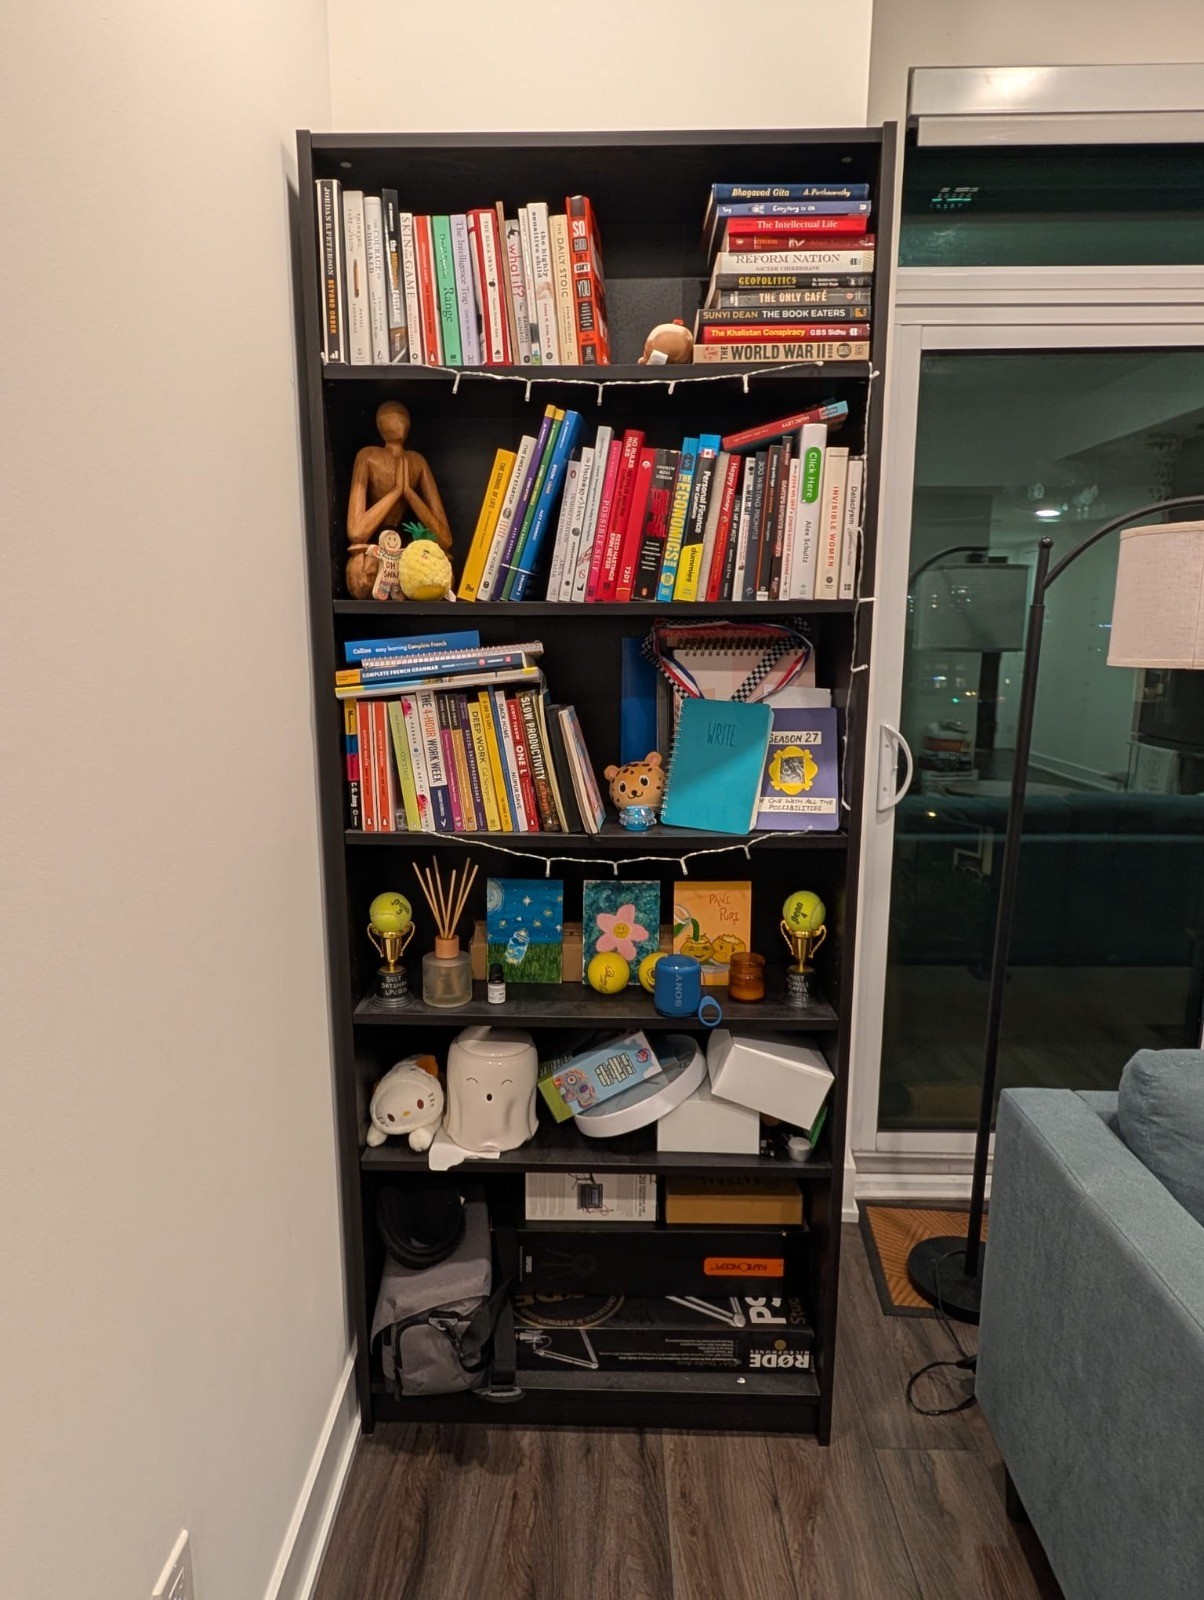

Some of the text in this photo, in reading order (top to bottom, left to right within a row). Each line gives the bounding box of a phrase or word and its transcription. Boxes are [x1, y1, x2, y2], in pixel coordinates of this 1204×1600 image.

[324, 187, 335, 221] JORDAN
[732, 188, 790, 201] Bhagavad Gita
[402, 217, 410, 248] SKIN
[572, 221, 586, 237] SO
[757, 220, 838, 229] The Intellectual Life
[326, 230, 335, 276] PETERSON
[374, 230, 382, 271] COURAGE
[532, 212, 544, 279] sensitive child
[456, 222, 472, 306] The Intelligence Trap
[508, 244, 525, 298] what if?
[540, 248, 550, 278] highly
[556, 238, 569, 298] DAILY STOIC
[736, 254, 840, 264] REFORM NATION
[390, 240, 401, 324] the FASTLANE
[406, 260, 416, 300] GAME
[578, 280, 591, 297] YOU
[328, 279, 336, 309] BEYOND
[443, 288, 455, 323] Range
[759, 290, 827, 303] THE ONLY CAFÉ
[703, 311, 730, 319] SUNYI
[762, 309, 846, 318] THE BOOK EATERS
[762, 329, 806, 337] Conspiracy
[828, 328, 847, 336] Sidhu
[720, 346, 728, 360] THE
[731, 344, 826, 361] WORLD WAR II
[624, 436, 633, 458] RULES
[628, 437, 639, 468] NO RULES
[498, 462, 506, 471] THE
[514, 456, 526, 479] SWEATY
[679, 474, 692, 483] THE
[806, 452, 818, 499] Click Here
[493, 472, 504, 490] SCHOOL
[508, 480, 520, 505] STARTUP
[574, 464, 591, 521] Psychology Money
[723, 462, 738, 512] Happy Money
[754, 476, 764, 508] WRITING
[488, 498, 497, 509] LIFE
[692, 493, 700, 519] Canadians
[695, 470, 711, 533] Personal Finance
[664, 483, 692, 560] ECONOMICS
[752, 509, 761, 540] PROMPTS
[828, 486, 840, 568] INVISIBLE WOMEN
[592, 500, 611, 572] POSSIBLE SELF
[802, 520, 812, 563] Alex Schultz
[488, 556, 497, 576] HUBER
[604, 548, 613, 569] MEYER
[608, 552, 619, 581] HASTINGS
[686, 548, 699, 583] dummies
[622, 566, 632, 584] T2D3
[352, 647, 372, 655] Collins
[387, 645, 408, 653] learning
[408, 642, 430, 652] Complete
[430, 640, 447, 649] French
[362, 670, 390, 679] COMPLETE
[390, 668, 411, 676] FRENCH
[412, 664, 439, 674] GRAMMAR
[498, 703, 510, 739] BACK HOME
[520, 696, 533, 722] SLOW
[420, 694, 443, 784] THE 4-HOUR WORK WEEK
[472, 711, 486, 763] DEEP WORK
[769, 732, 819, 744] SEASON 27
[516, 745, 525, 766] ONE
[524, 722, 546, 780] PRODUCTIVITY
[418, 784, 424, 792] OF
[468, 750, 481, 803] ENTREPRENEURSHIP
[511, 772, 520, 794] NUPUR
[350, 794, 358, 807] Jung
[482, 778, 492, 803] Newport
[708, 893, 731, 907] PANI
[790, 902, 804, 925] Penn
[674, 974, 683, 1008] SONY
[748, 1354, 810, 1369] RØDE
